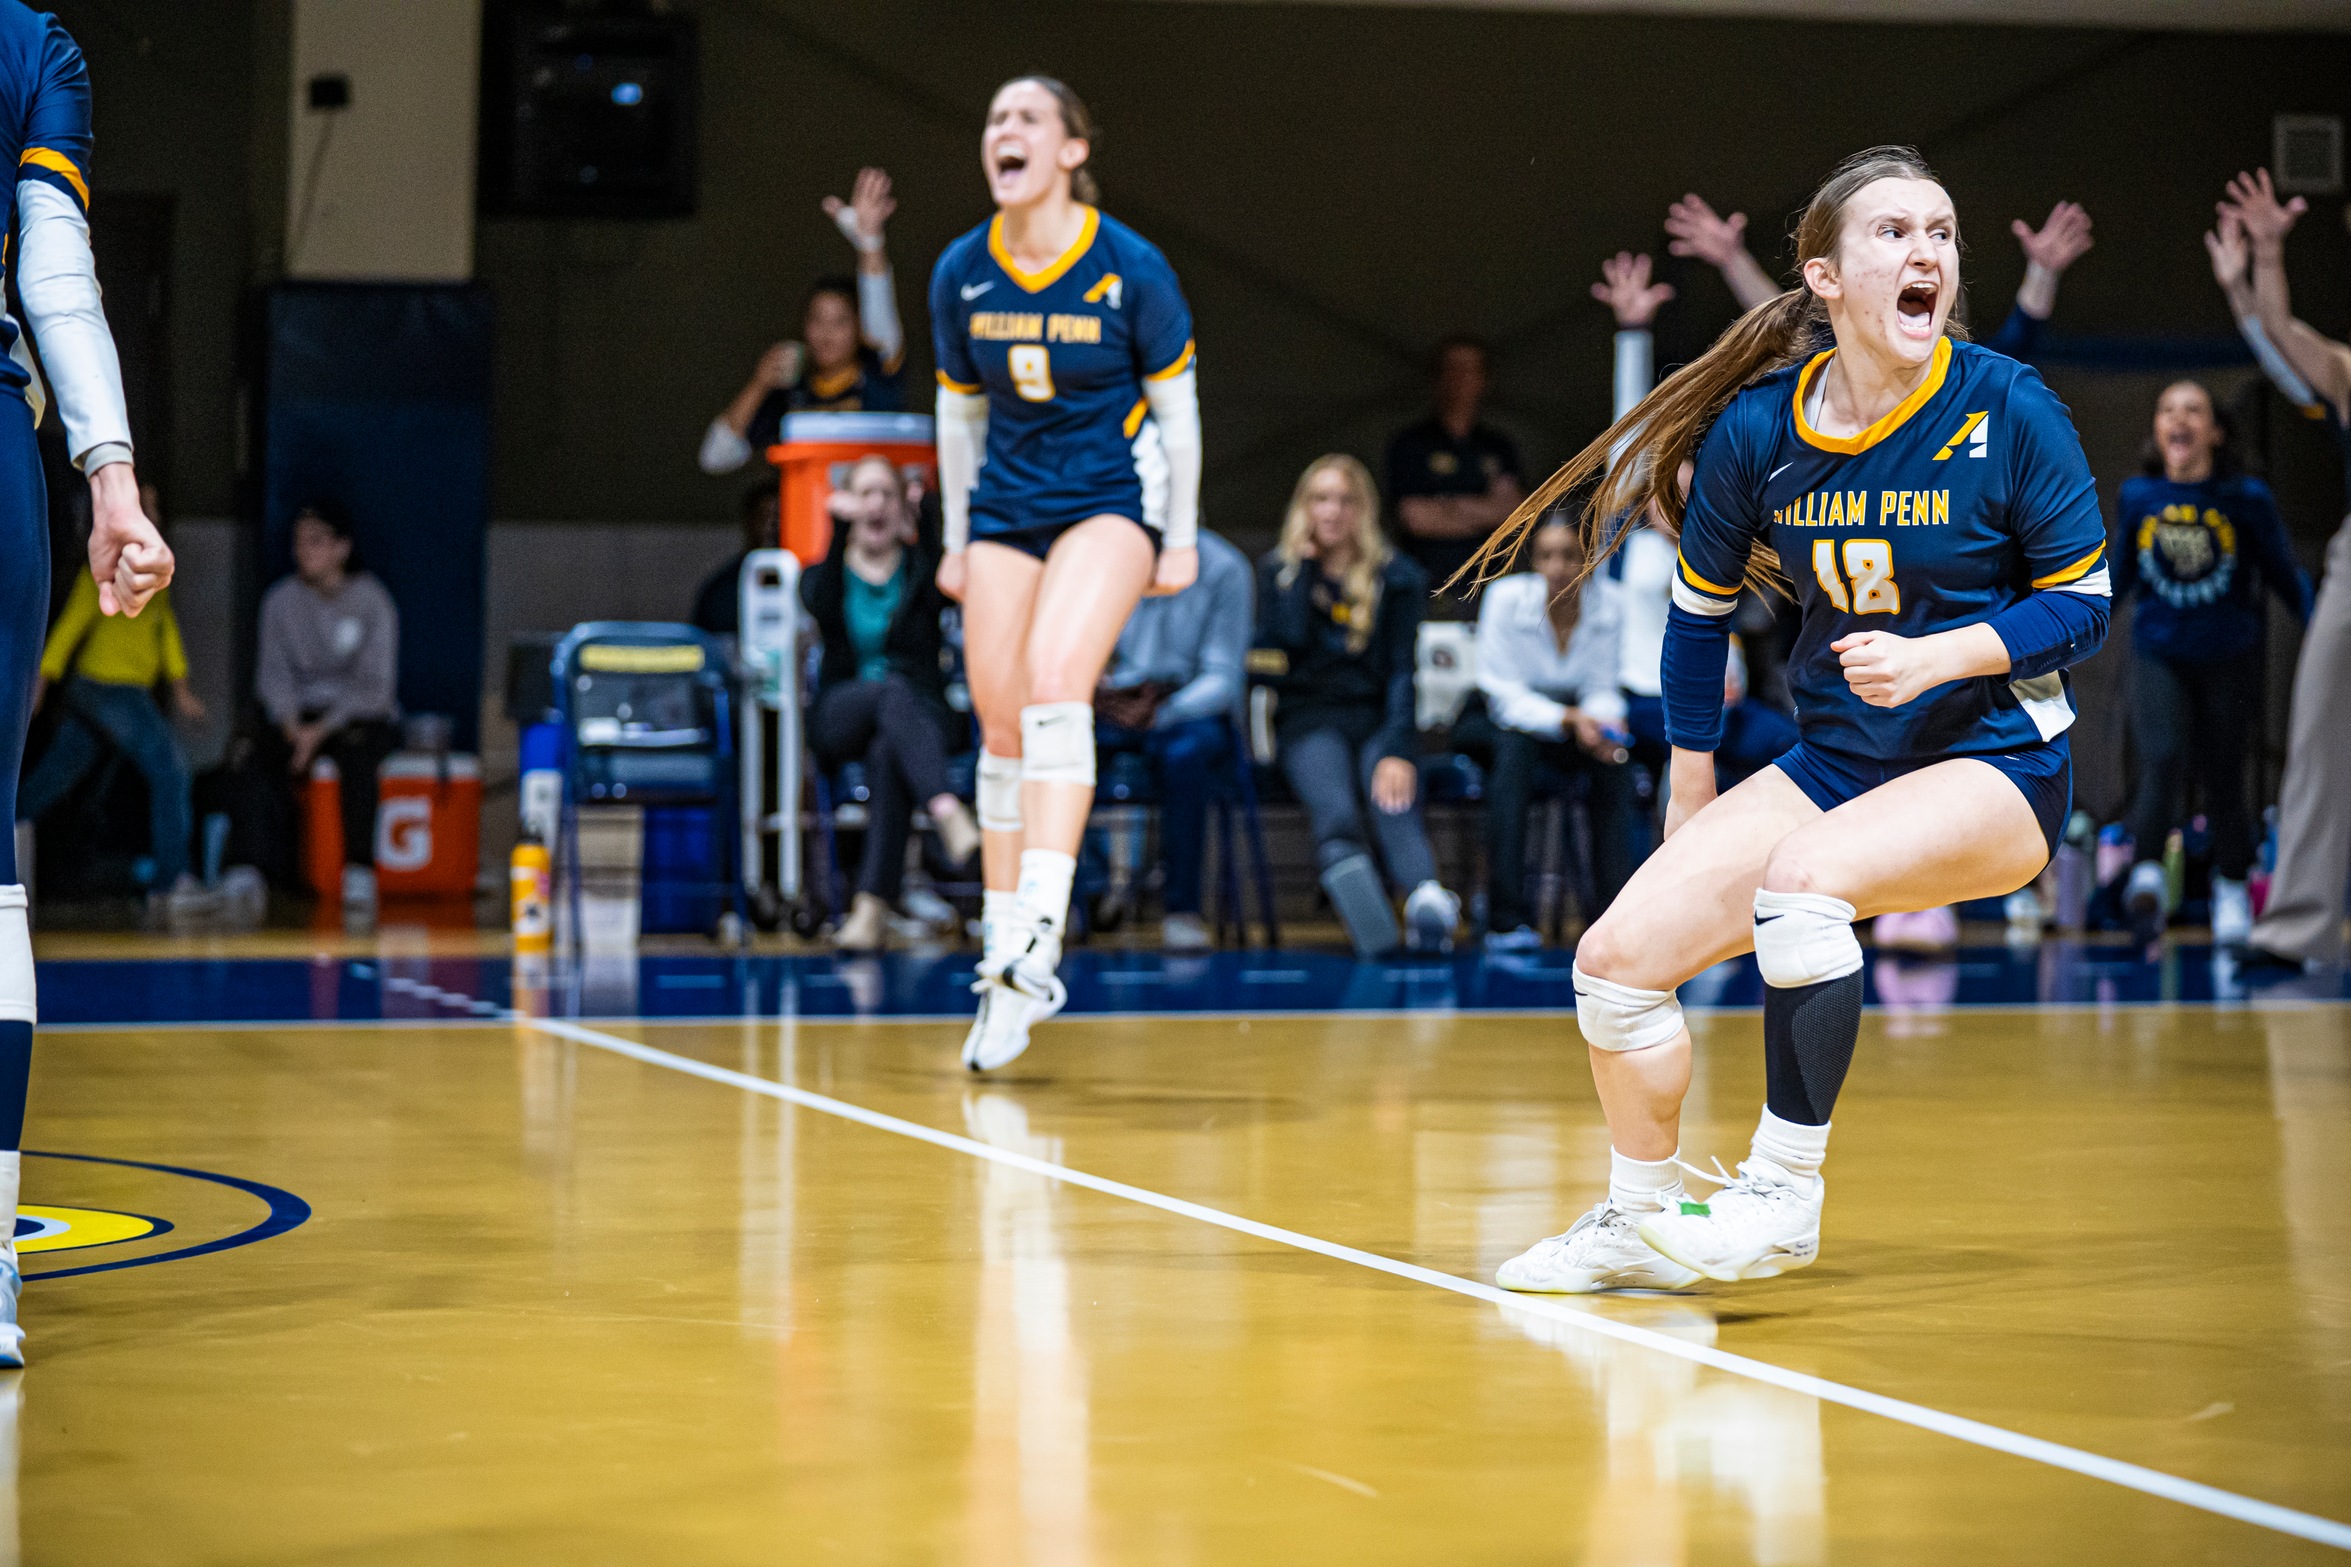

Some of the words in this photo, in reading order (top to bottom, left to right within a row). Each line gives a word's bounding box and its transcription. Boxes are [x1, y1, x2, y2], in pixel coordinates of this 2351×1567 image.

[1046, 313, 1101, 344] PENN
[1007, 344, 1056, 402] 9
[1879, 490, 1950, 526] PENN
[1812, 538, 1900, 615] 18
[373, 796, 433, 872] G
